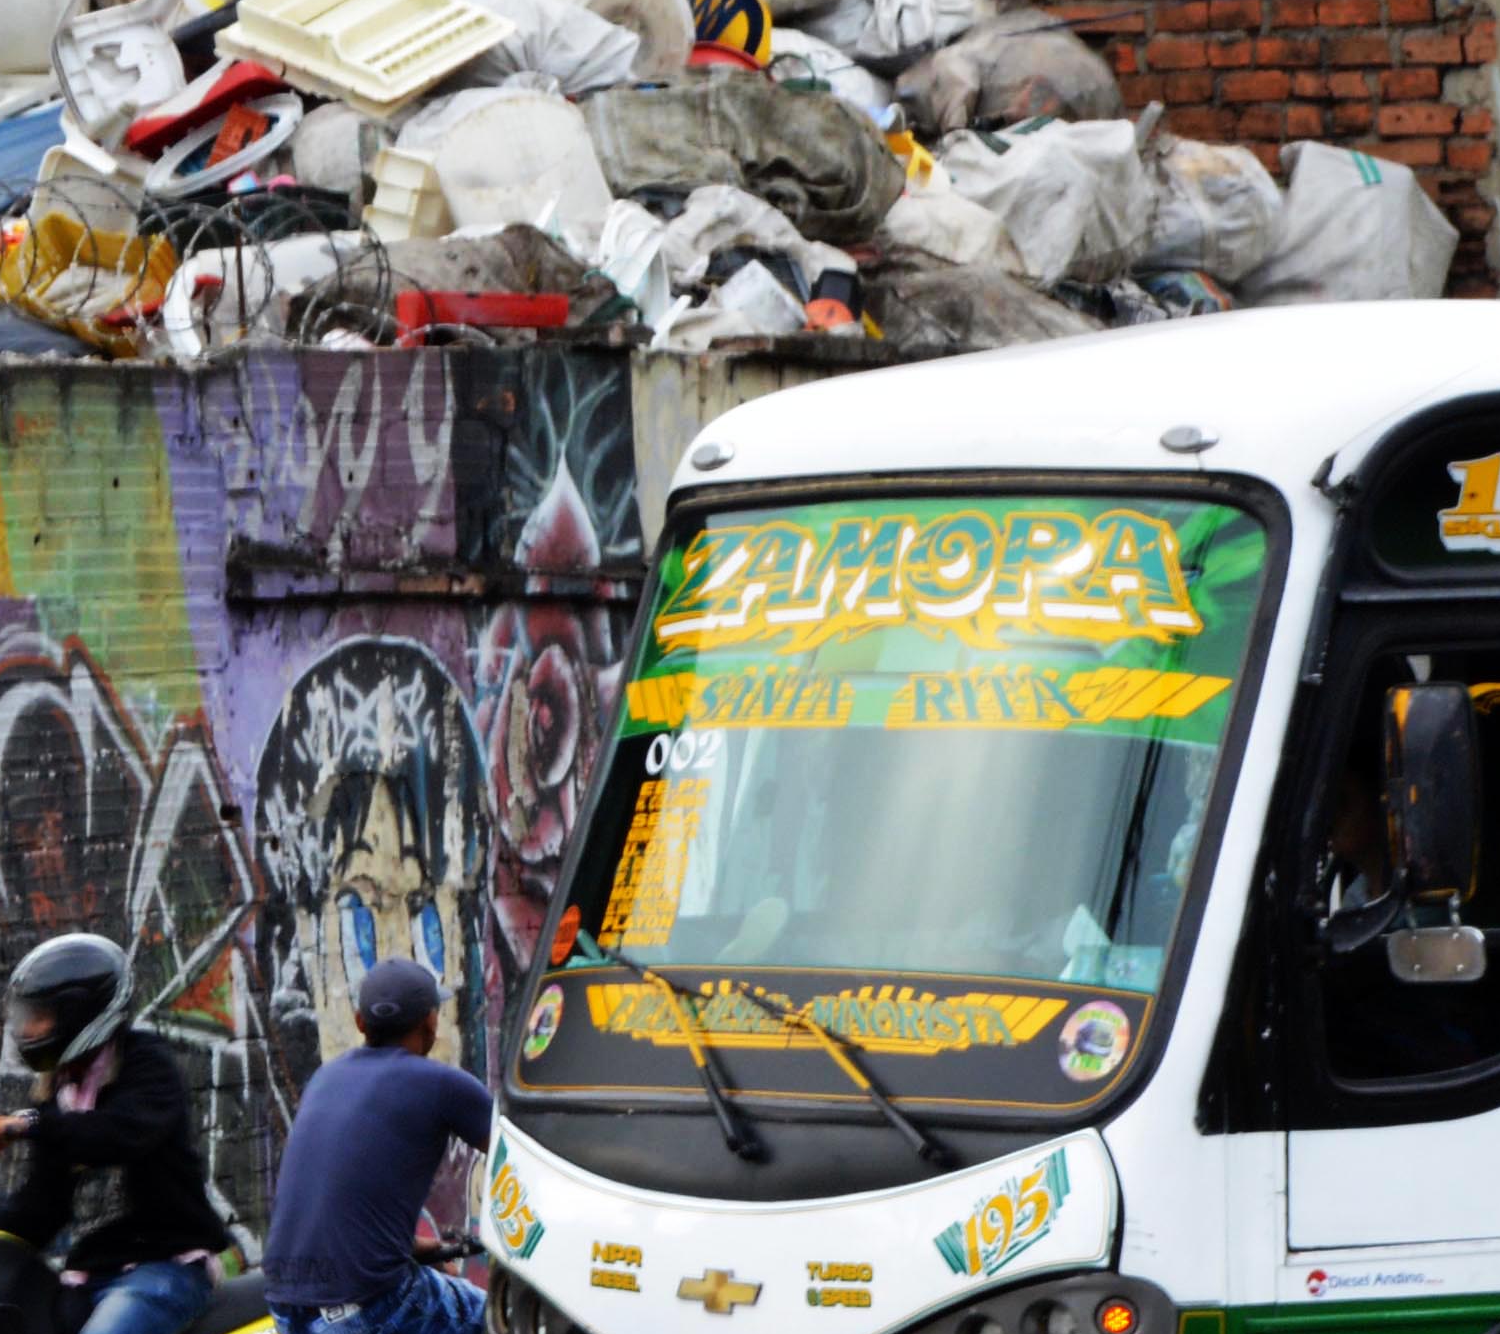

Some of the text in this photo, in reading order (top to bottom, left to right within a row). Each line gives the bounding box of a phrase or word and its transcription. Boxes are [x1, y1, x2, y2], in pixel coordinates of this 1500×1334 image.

[655, 509, 1204, 645] ZAMORA
[702, 670, 1084, 721] SANTA RITA
[645, 730, 723, 775] 002
[812, 995, 1018, 1045] MINORISTA
